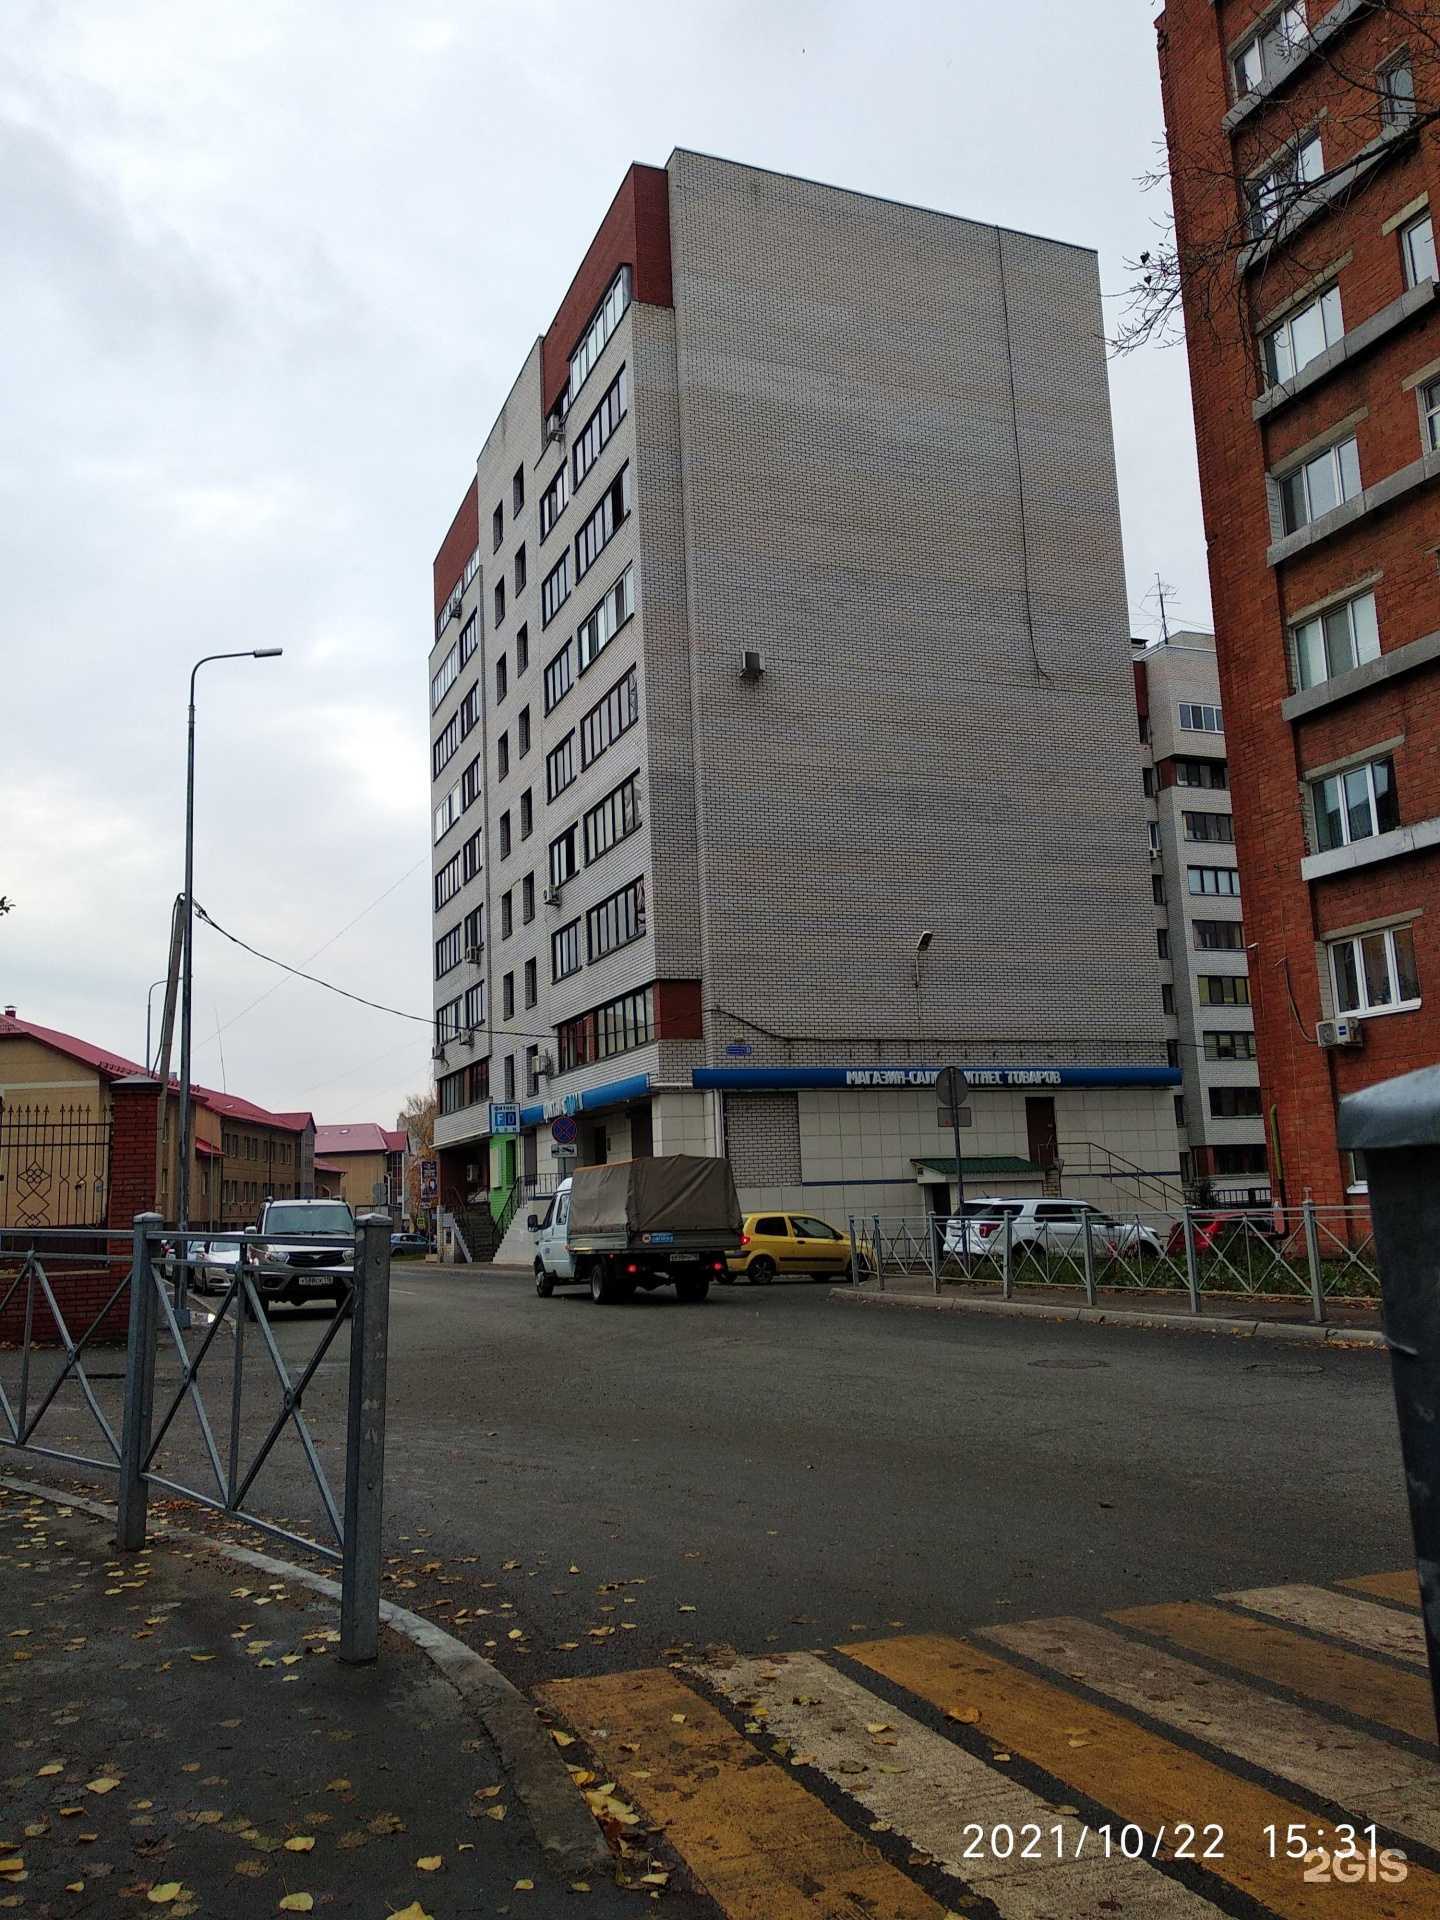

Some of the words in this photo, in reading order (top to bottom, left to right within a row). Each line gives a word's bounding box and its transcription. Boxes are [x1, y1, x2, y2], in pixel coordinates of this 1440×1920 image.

[846, 1070, 938, 1084] МАГАЗИН-САЛ
[963, 1070, 1004, 1084] ИТНЕС
[1004, 1070, 1062, 1084] ТОВАРОВ
